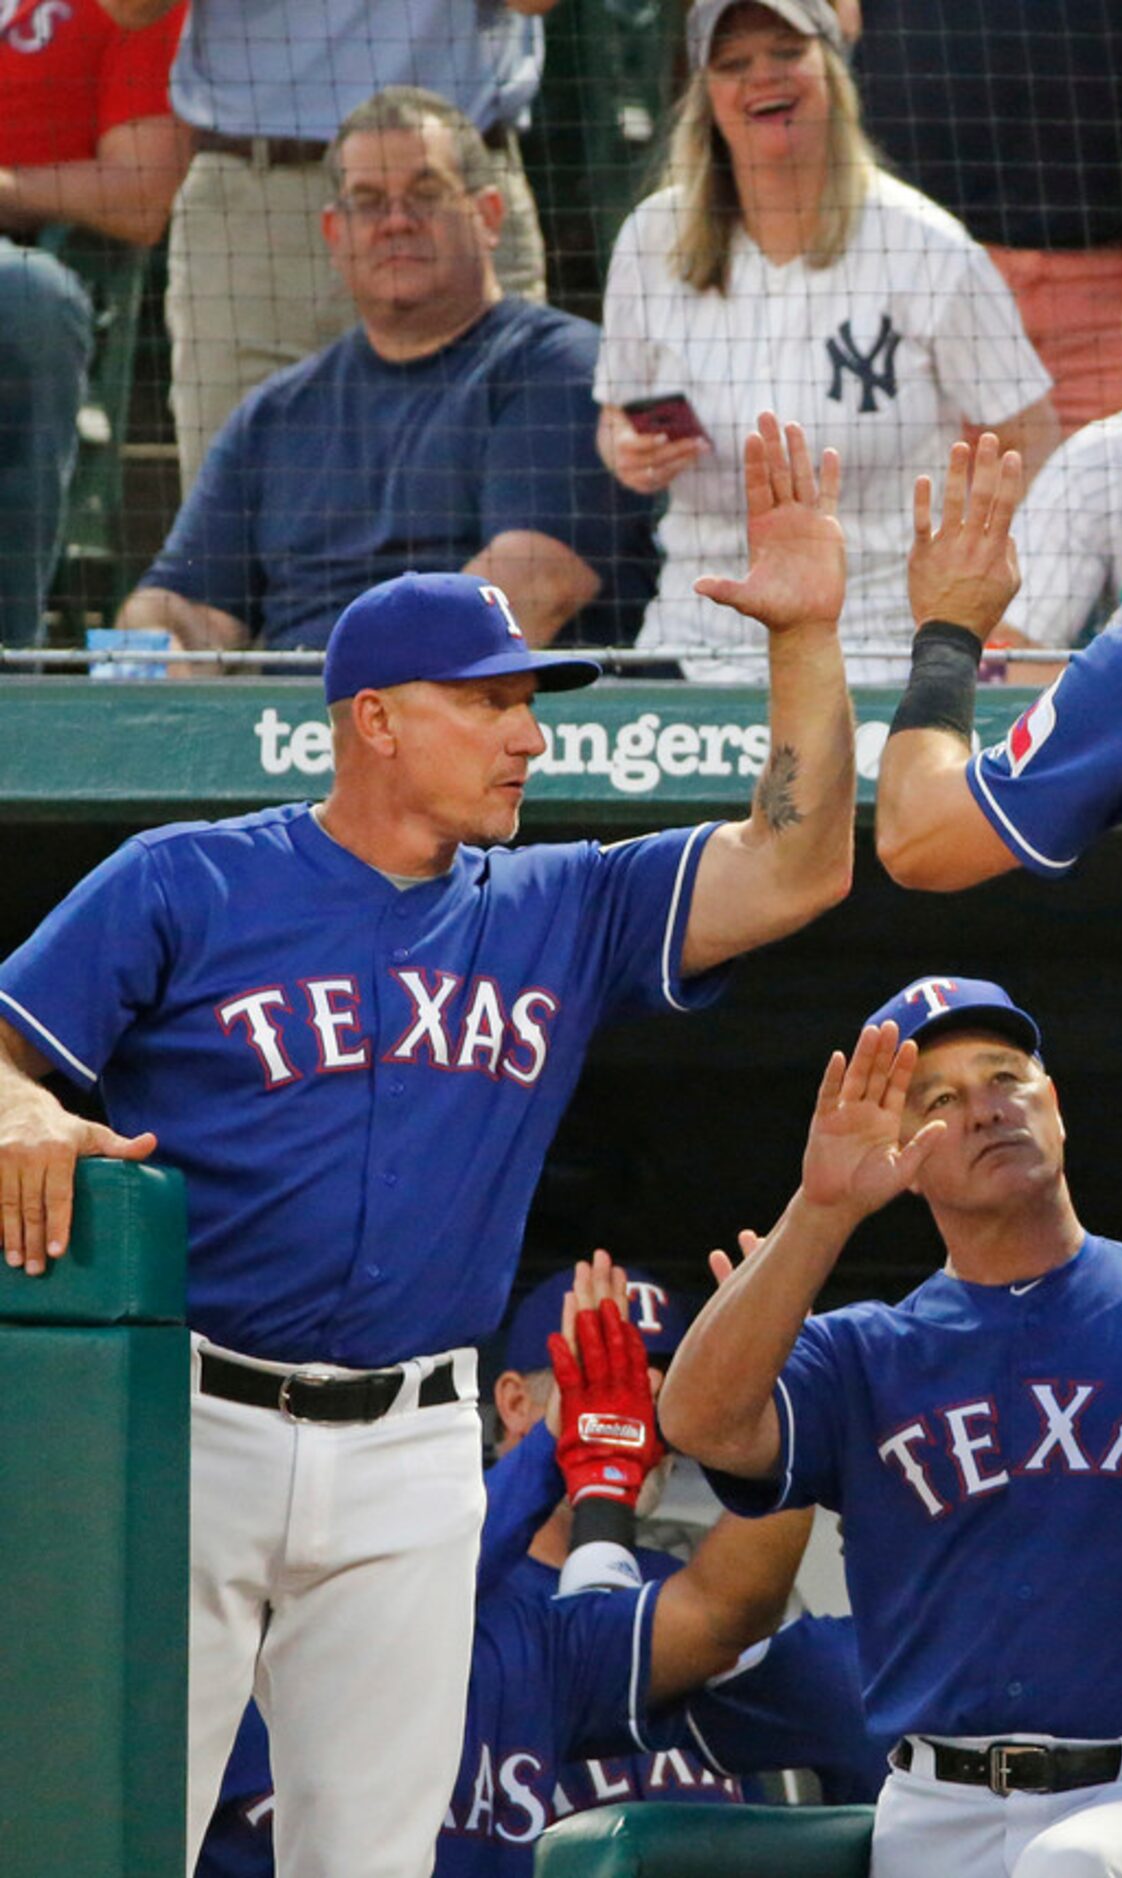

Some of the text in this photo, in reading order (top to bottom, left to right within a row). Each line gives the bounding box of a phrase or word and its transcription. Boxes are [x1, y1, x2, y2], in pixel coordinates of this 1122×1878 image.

[825, 312, 902, 413] NY
[479, 586, 523, 639] T
[527, 713, 770, 793] angers
[215, 967, 561, 1090] TEXAS
[904, 977, 958, 1020] T
[625, 1281, 668, 1332] T
